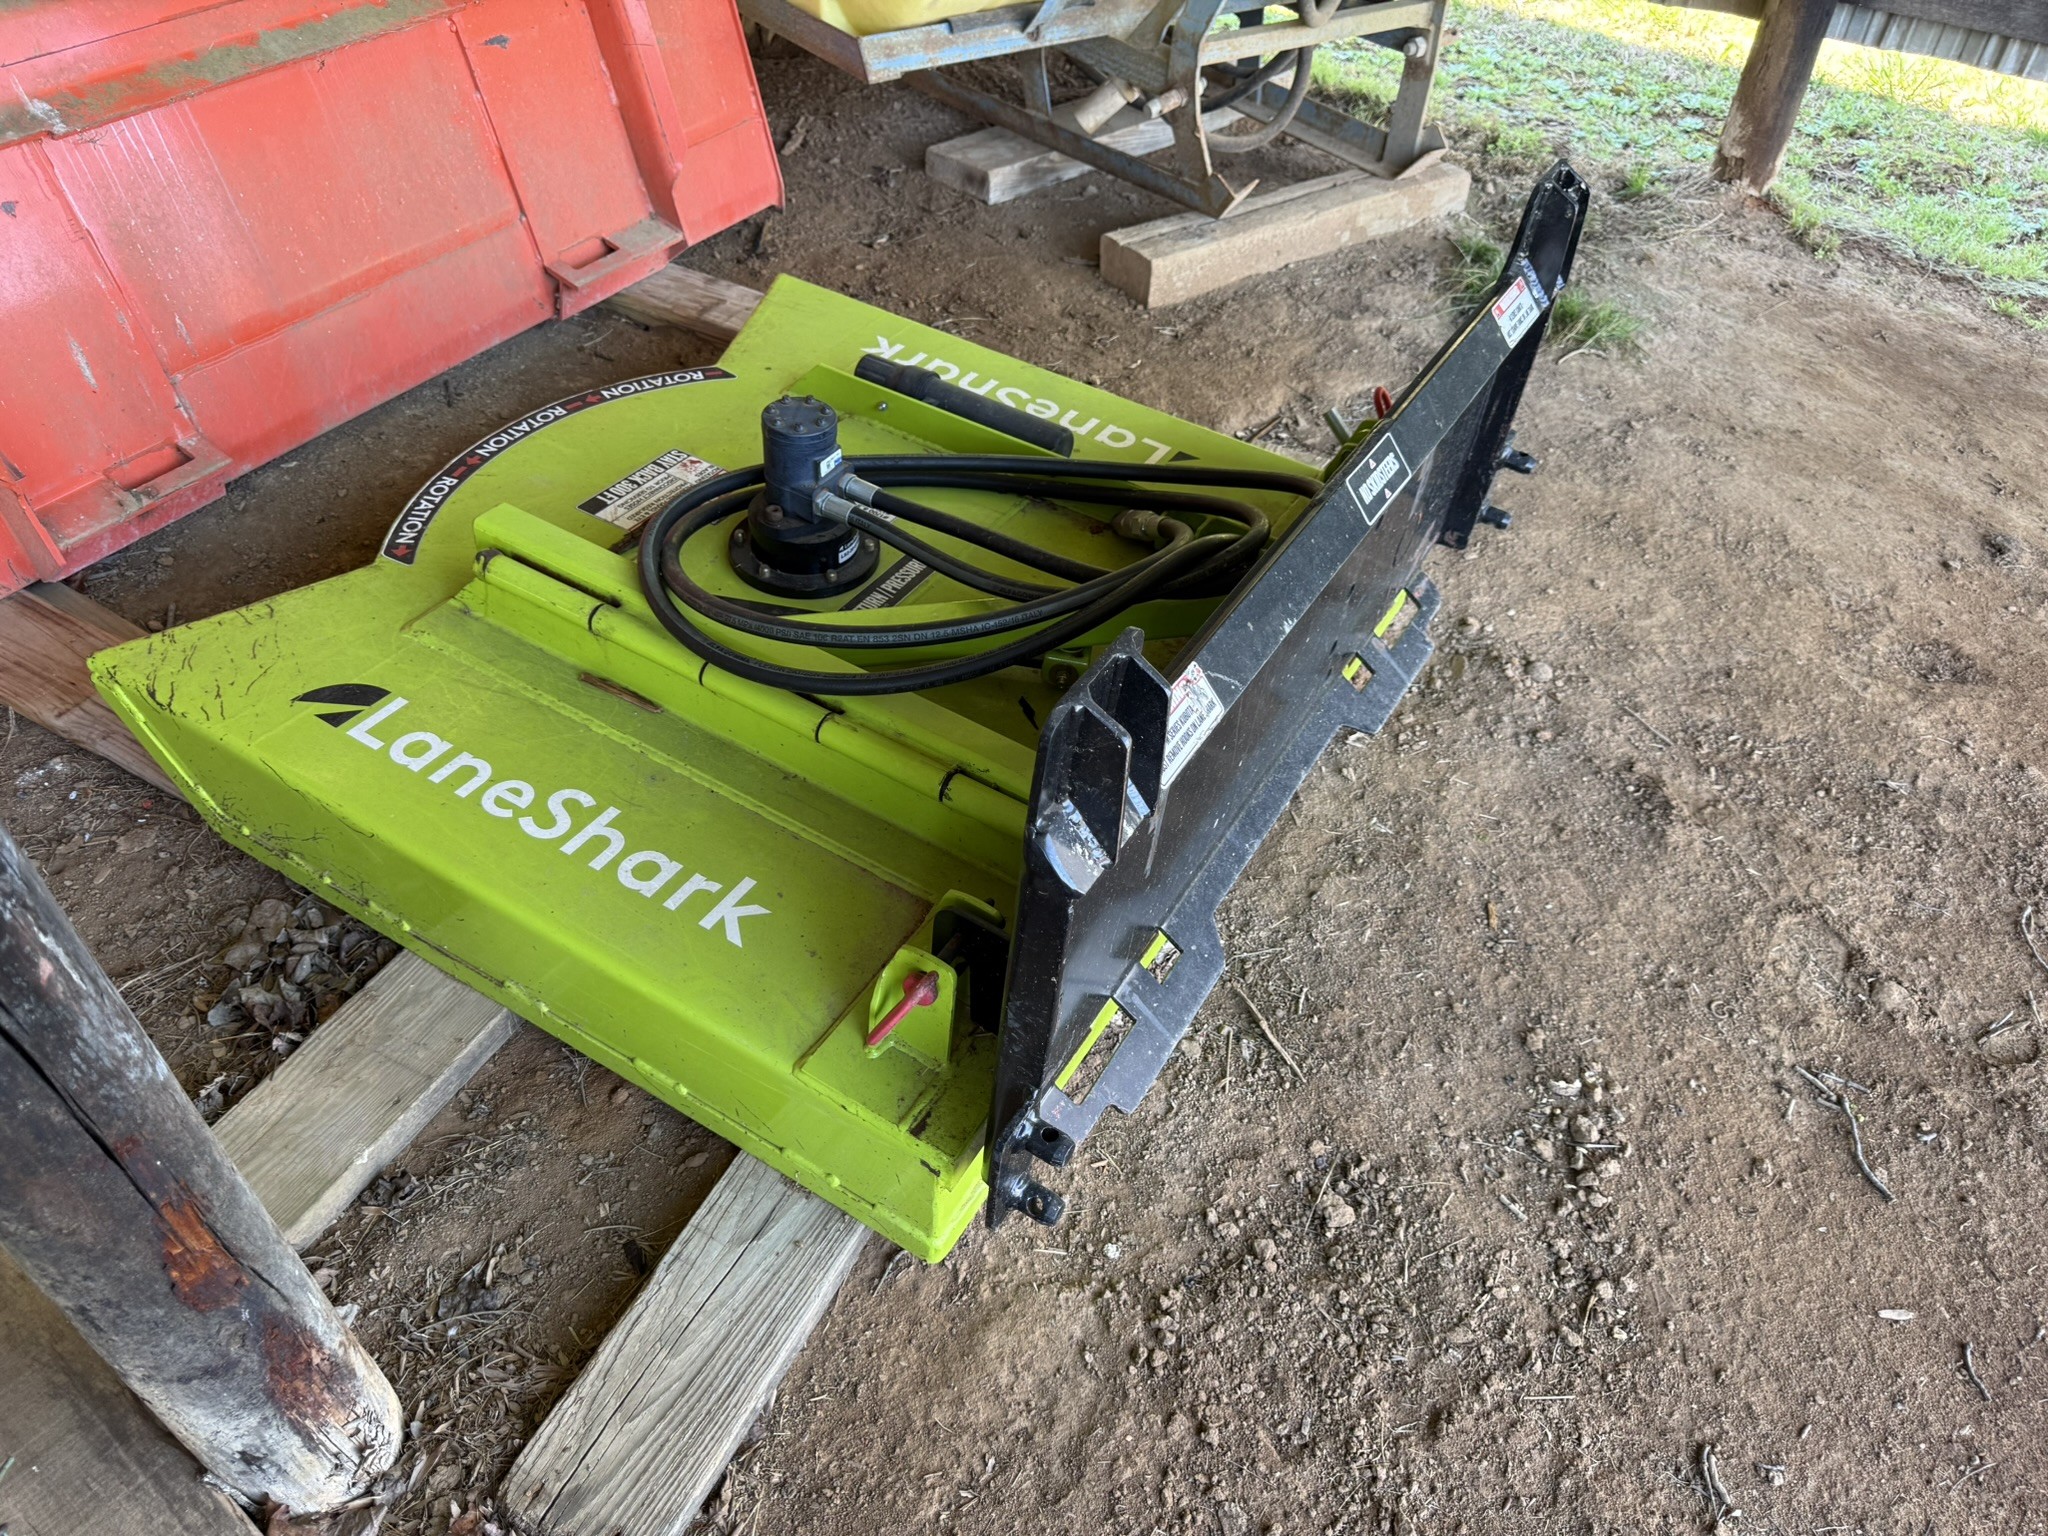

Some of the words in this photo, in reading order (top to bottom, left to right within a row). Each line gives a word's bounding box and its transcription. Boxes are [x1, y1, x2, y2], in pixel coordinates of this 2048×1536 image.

[601, 370, 706, 400] ROTATION
[475, 405, 568, 457] ROTATION
[627, 462, 665, 488] BACK
[656, 450, 689, 473] STAY
[596, 491, 620, 505] FT
[608, 479, 638, 500] 300
[395, 476, 459, 544] ROTATION
[881, 558, 927, 594] PRESSUR
[876, 588, 894, 598] /
[793, 631, 811, 641] SAE
[831, 634, 855, 643] R2AT
[857, 635, 870, 643] EN
[873, 635, 890, 643] 853
[891, 633, 911, 642] 2SN
[913, 632, 929, 641] DN
[931, 629, 949, 639] 12.5
[951, 624, 980, 637] MSHA
[981, 616, 1020, 633] IC-152/16
[1021, 609, 1044, 621] ITALY
[1166, 741, 1183, 764] REMOVE
[1180, 727, 1195, 747] HOOKS
[1167, 721, 1183, 741] SERIES
[346, 697, 772, 948] LaneShark
